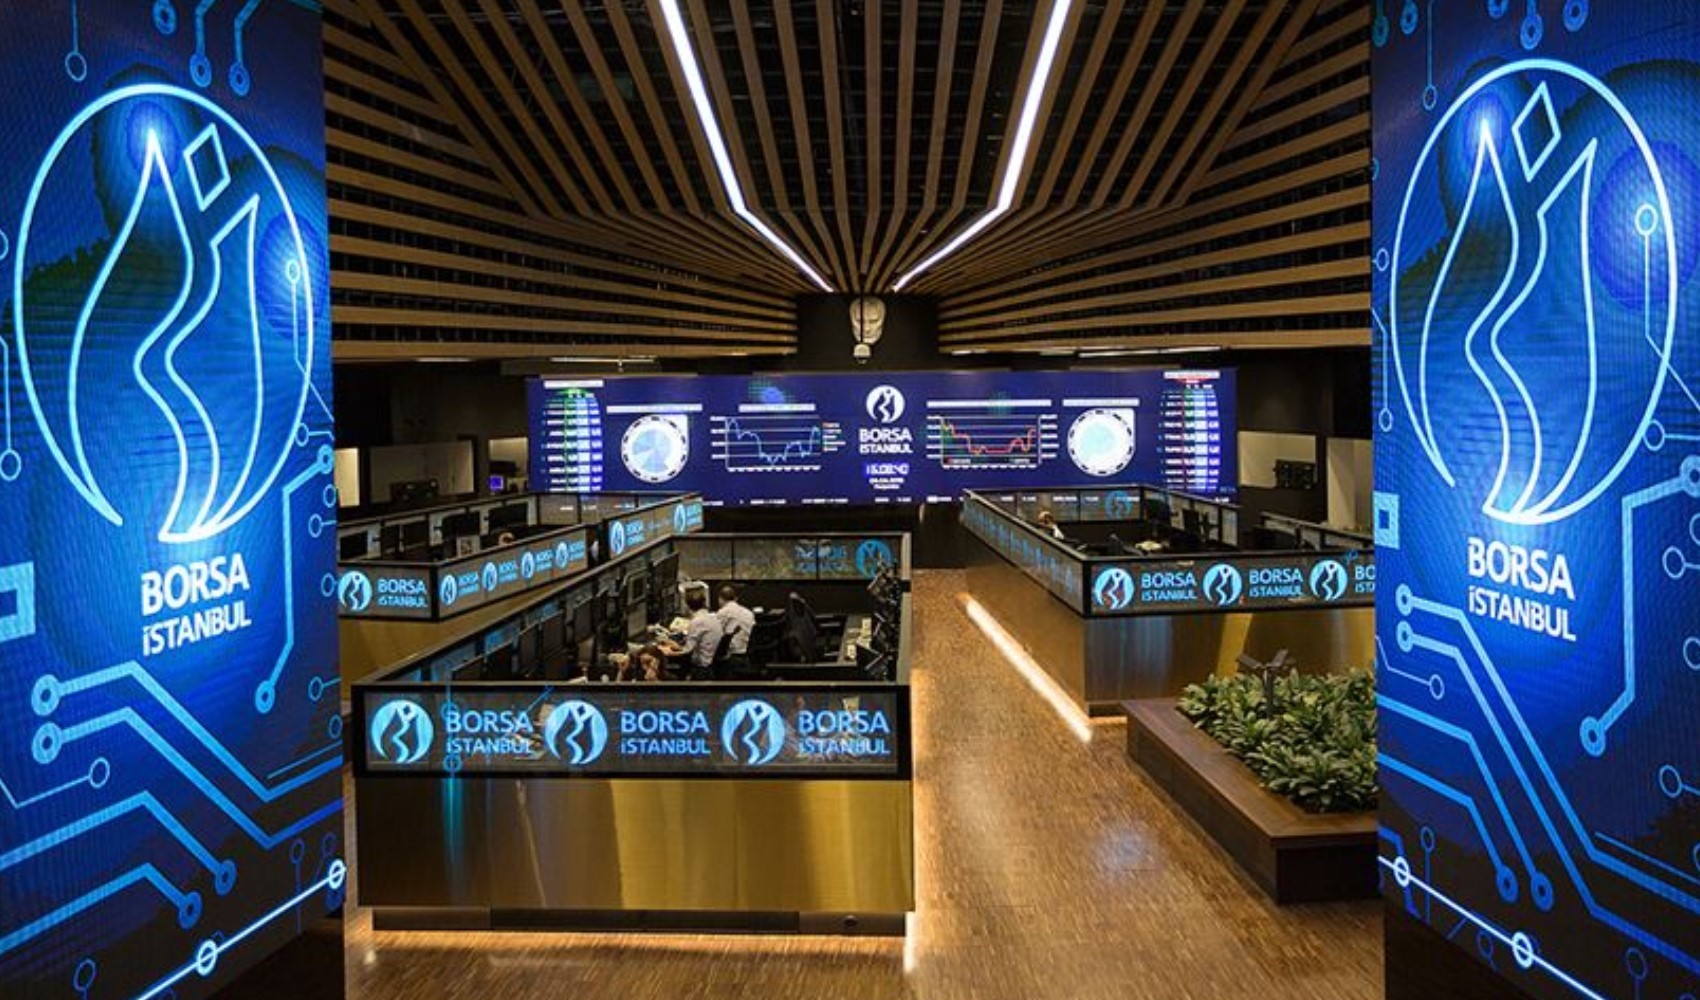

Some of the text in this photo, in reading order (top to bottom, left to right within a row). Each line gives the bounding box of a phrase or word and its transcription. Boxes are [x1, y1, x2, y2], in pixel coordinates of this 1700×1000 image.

[859, 427, 913, 442] BORSA
[1141, 571, 1196, 588] BORSA
[1249, 567, 1303, 584] BORSA
[1467, 536, 1575, 601] BORSA
[141, 552, 250, 616] BORSA
[377, 578, 426, 594] BORSA
[446, 711, 534, 733] BORSA
[620, 711, 710, 733] BORSA
[799, 711, 890, 733] BORSA
